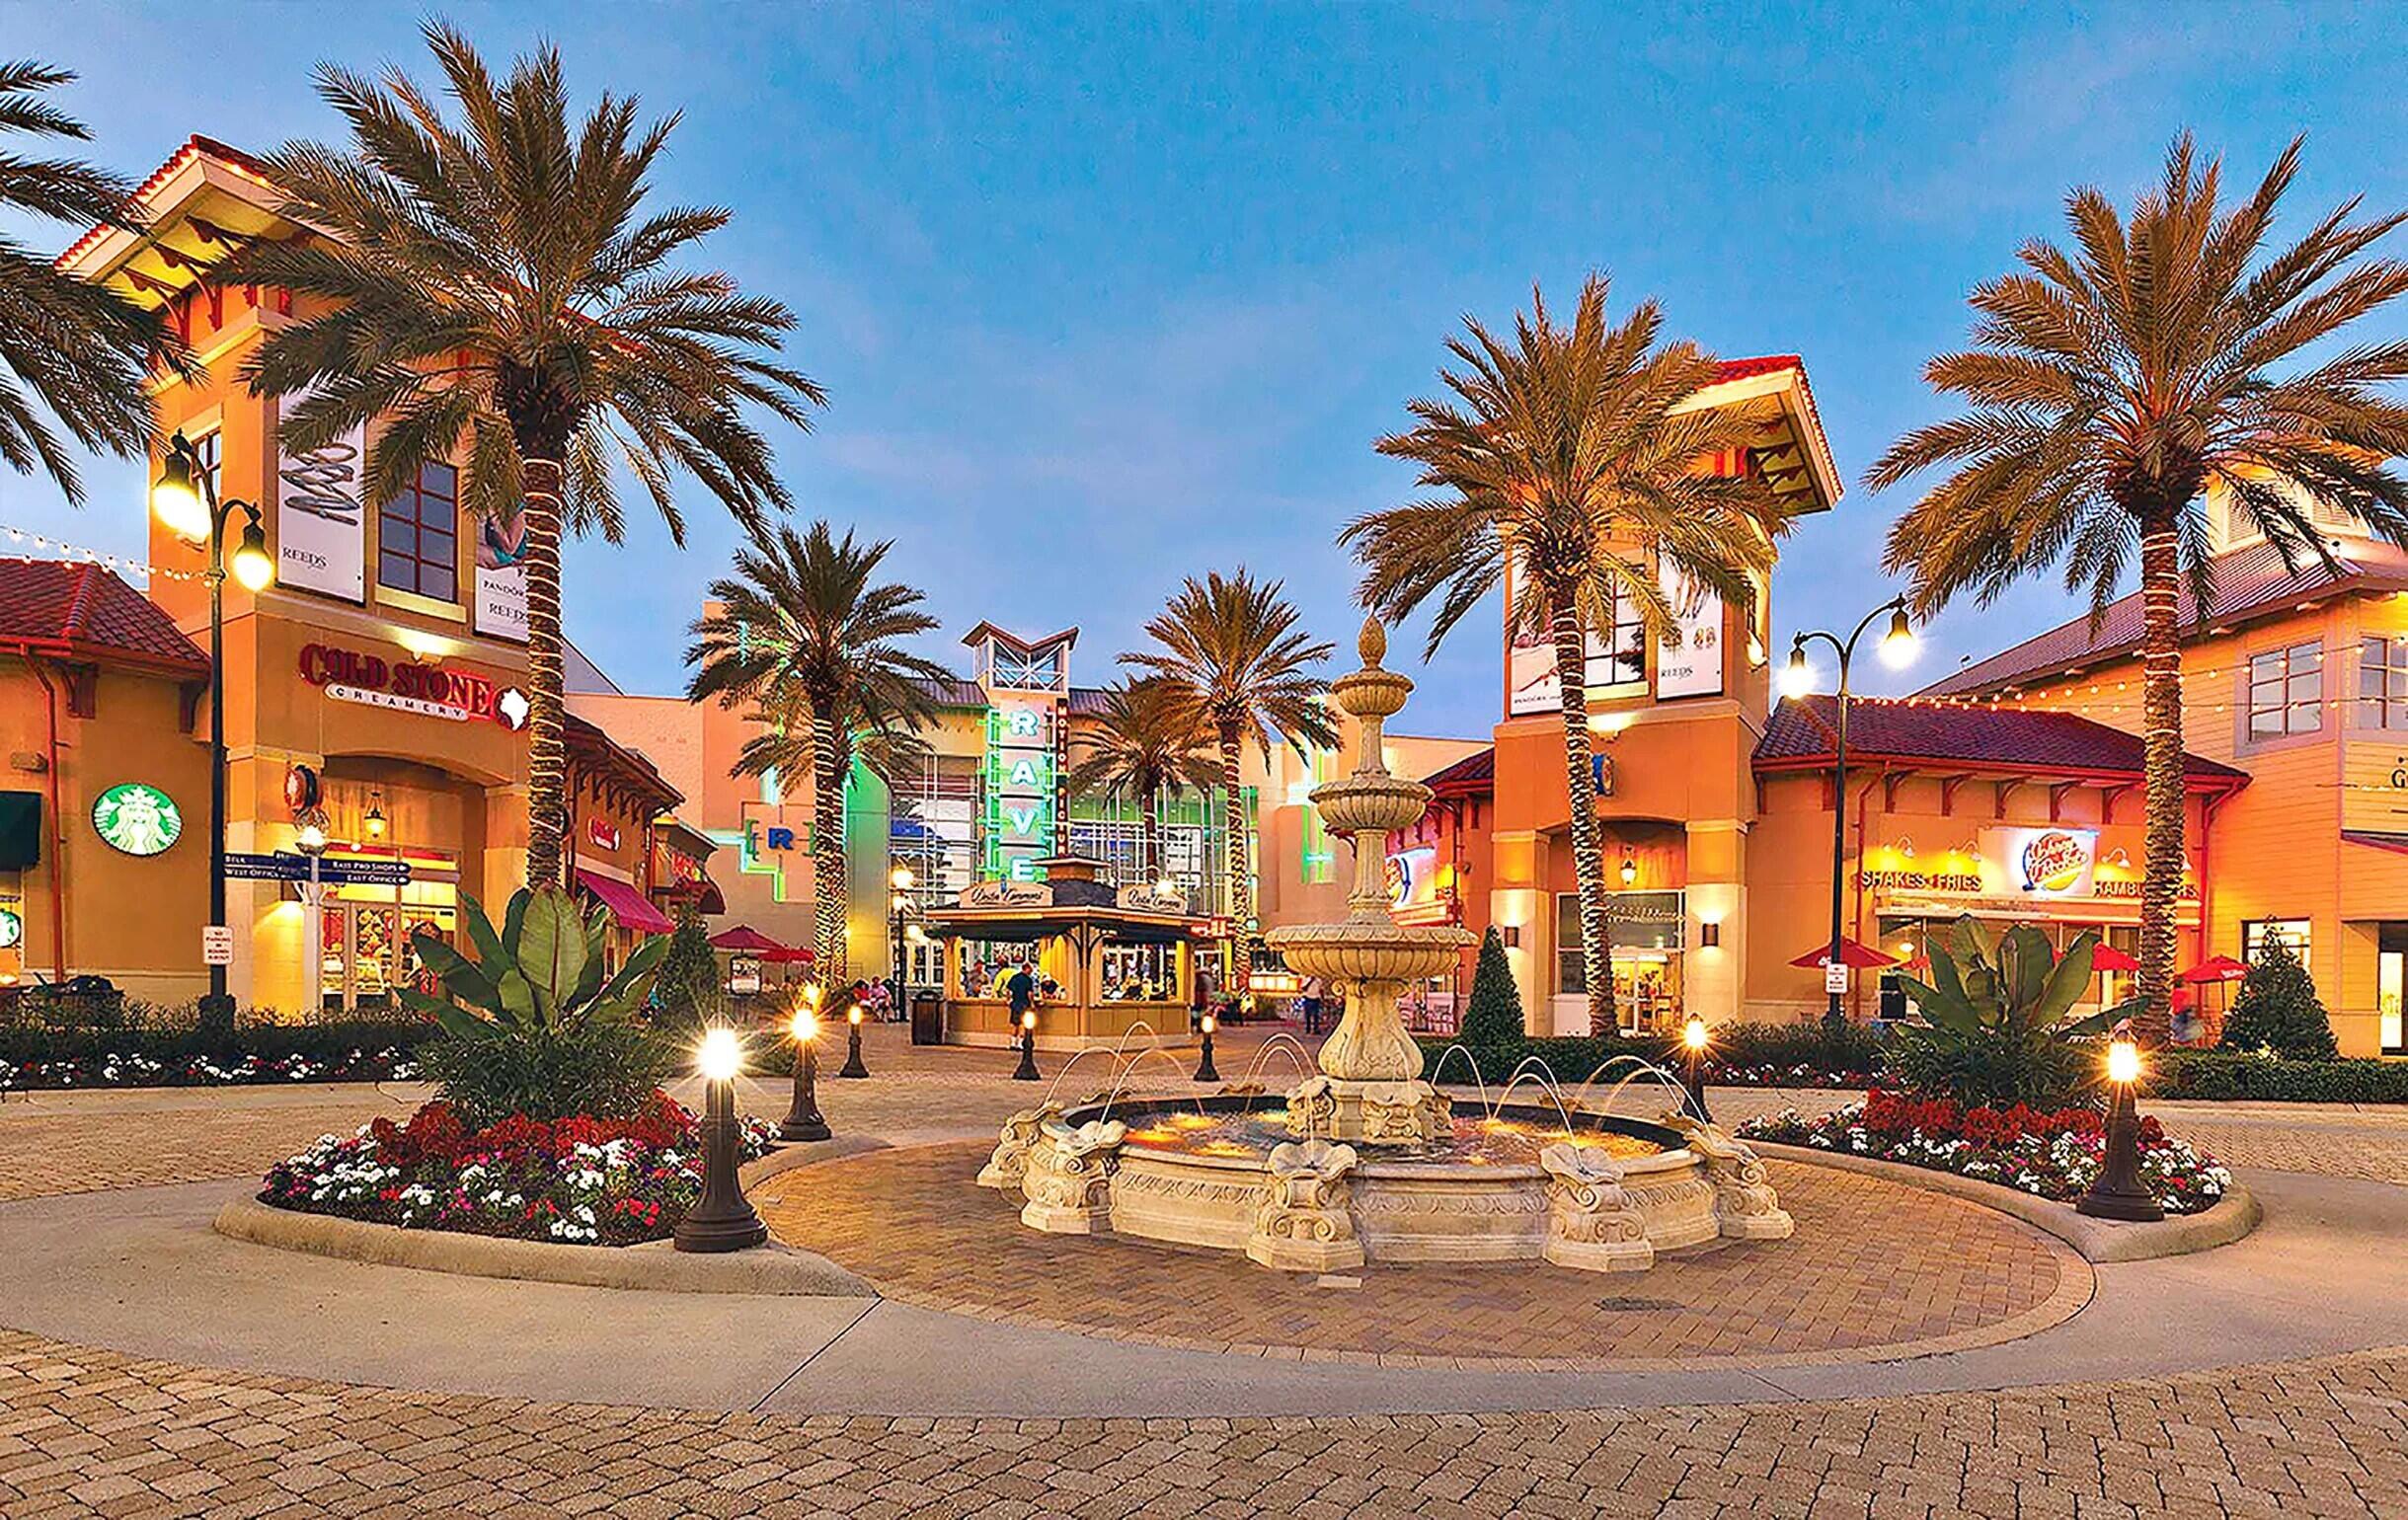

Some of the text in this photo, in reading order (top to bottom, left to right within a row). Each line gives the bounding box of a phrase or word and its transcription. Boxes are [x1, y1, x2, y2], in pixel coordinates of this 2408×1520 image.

[484, 579, 525, 597] PANDOR
[299, 643, 494, 718] COLD STONE
[335, 687, 465, 718] CREAMERY
[1056, 706, 1068, 856] MOTION PICTUR
[1009, 709, 1039, 882] RAVE
[347, 874, 398, 883] EAST OFFICE
[353, 862, 371, 871] PRO
[371, 863, 398, 872] SHOPS
[1861, 871, 1983, 892] SHAKES FRIES
